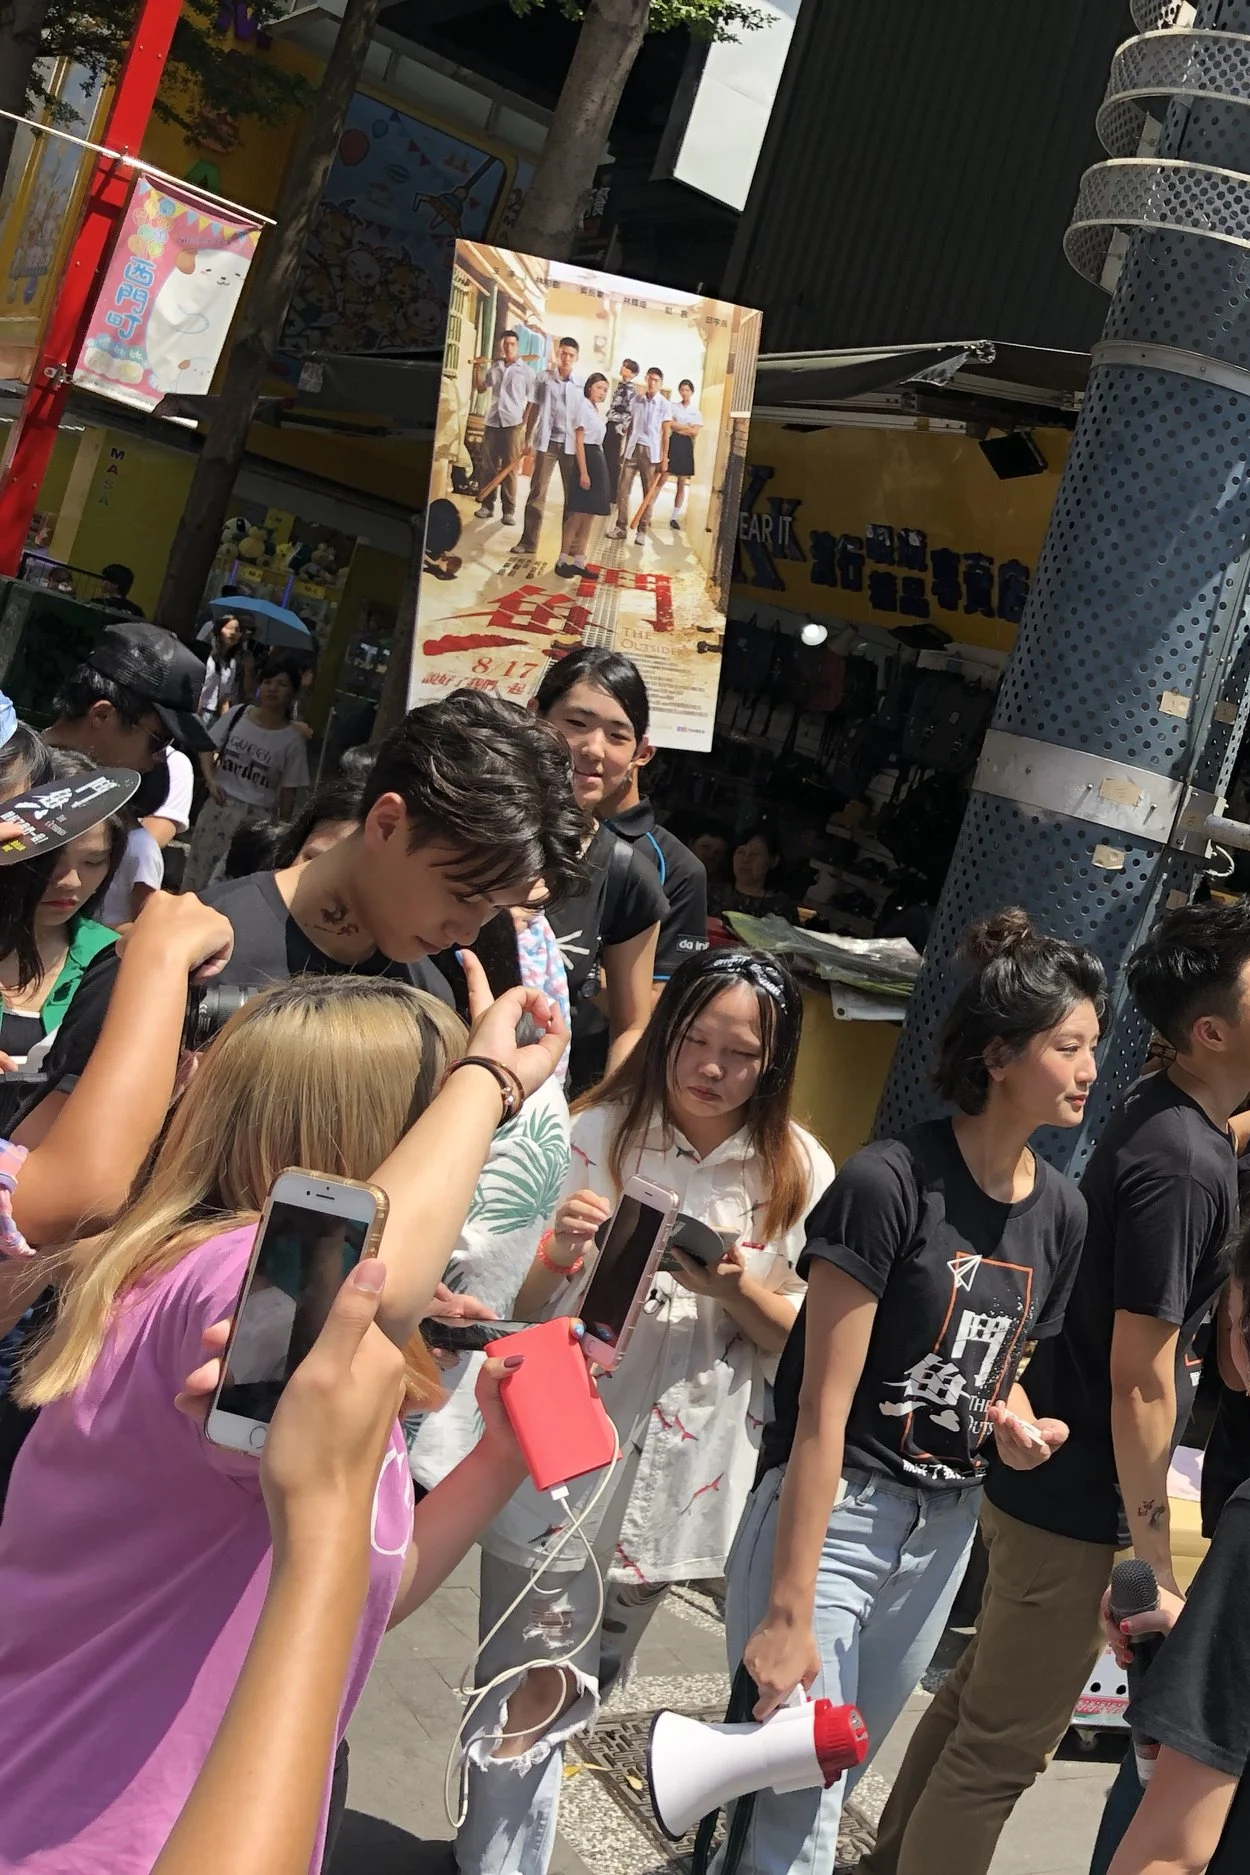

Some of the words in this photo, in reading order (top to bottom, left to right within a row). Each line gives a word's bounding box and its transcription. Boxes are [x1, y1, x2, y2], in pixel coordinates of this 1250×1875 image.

[106, 255, 155, 340] 西門町
[776, 515, 793, 545] IT
[621, 616, 653, 641] THE
[471, 656, 540, 679] 8/17
[221, 759, 271, 789] arden
